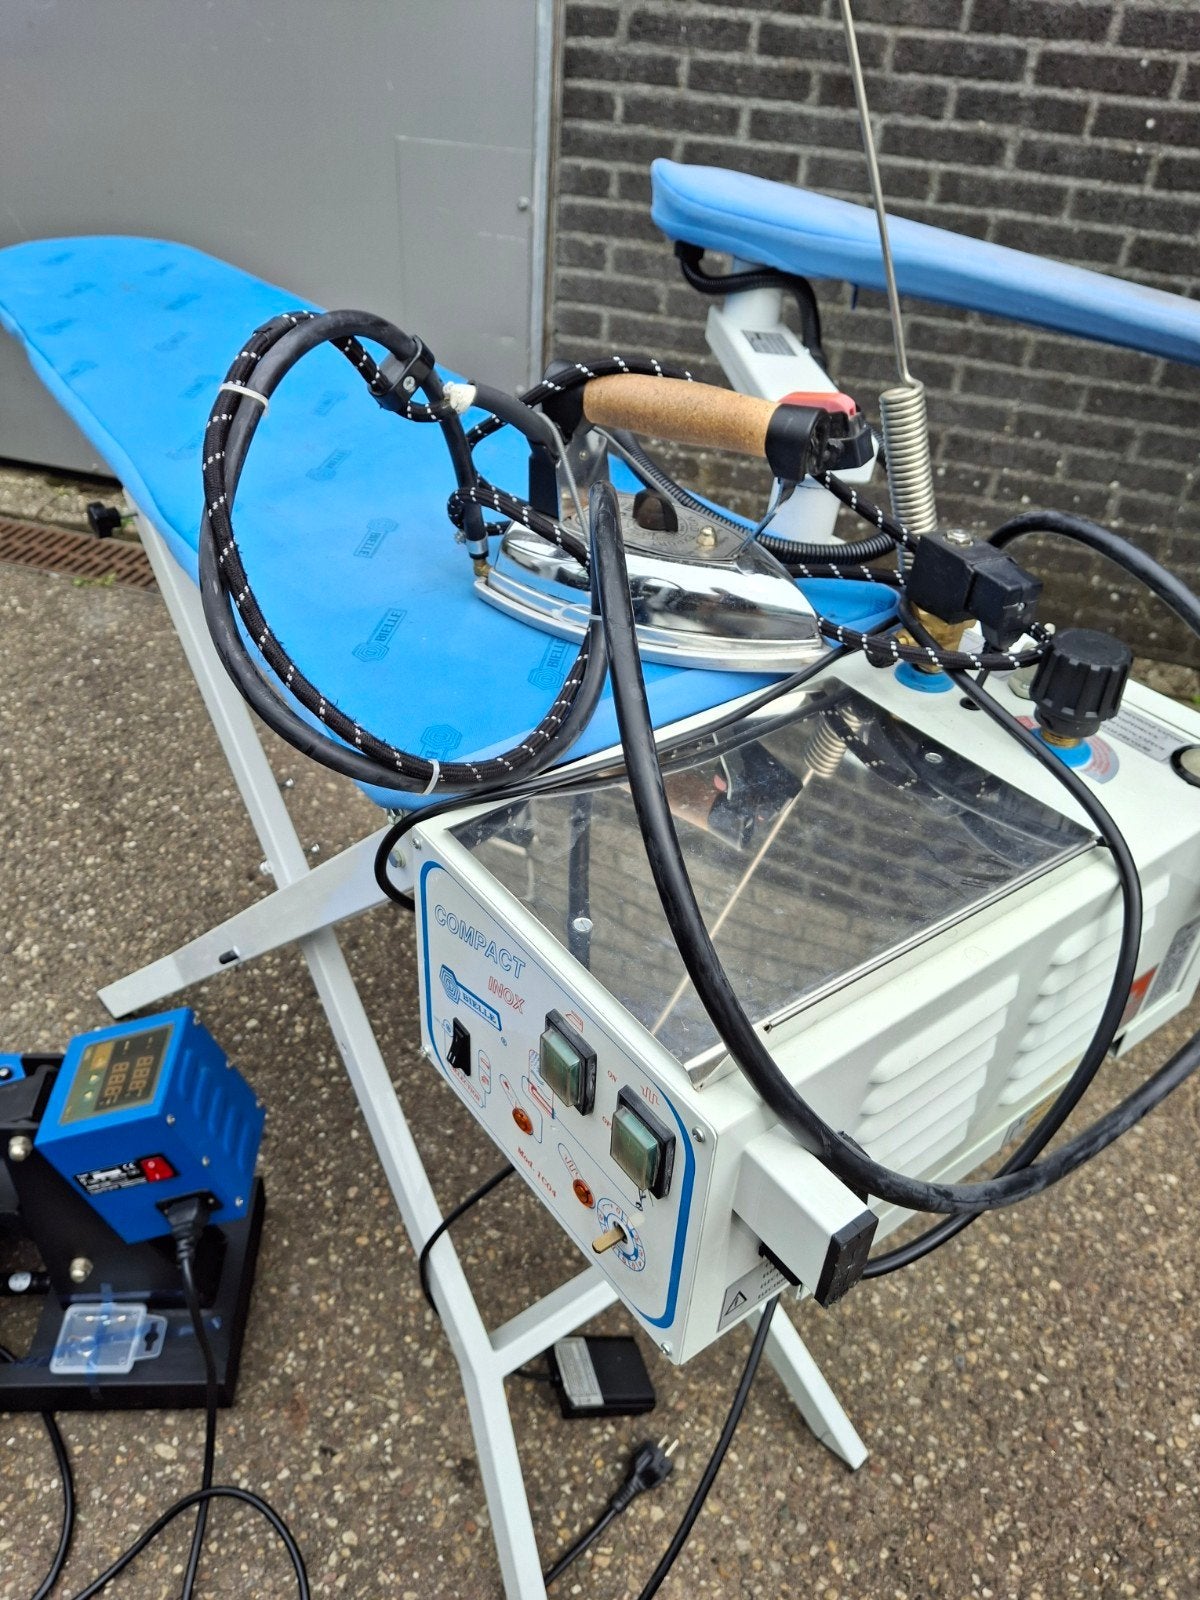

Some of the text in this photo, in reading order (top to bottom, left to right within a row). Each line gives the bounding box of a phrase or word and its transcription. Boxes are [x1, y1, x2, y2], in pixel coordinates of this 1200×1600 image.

[375, 610, 402, 642] BIELLE
[434, 904, 527, 979] COMPACT
[462, 992, 498, 1025] BIELLE
[487, 975, 524, 1015] INOX
